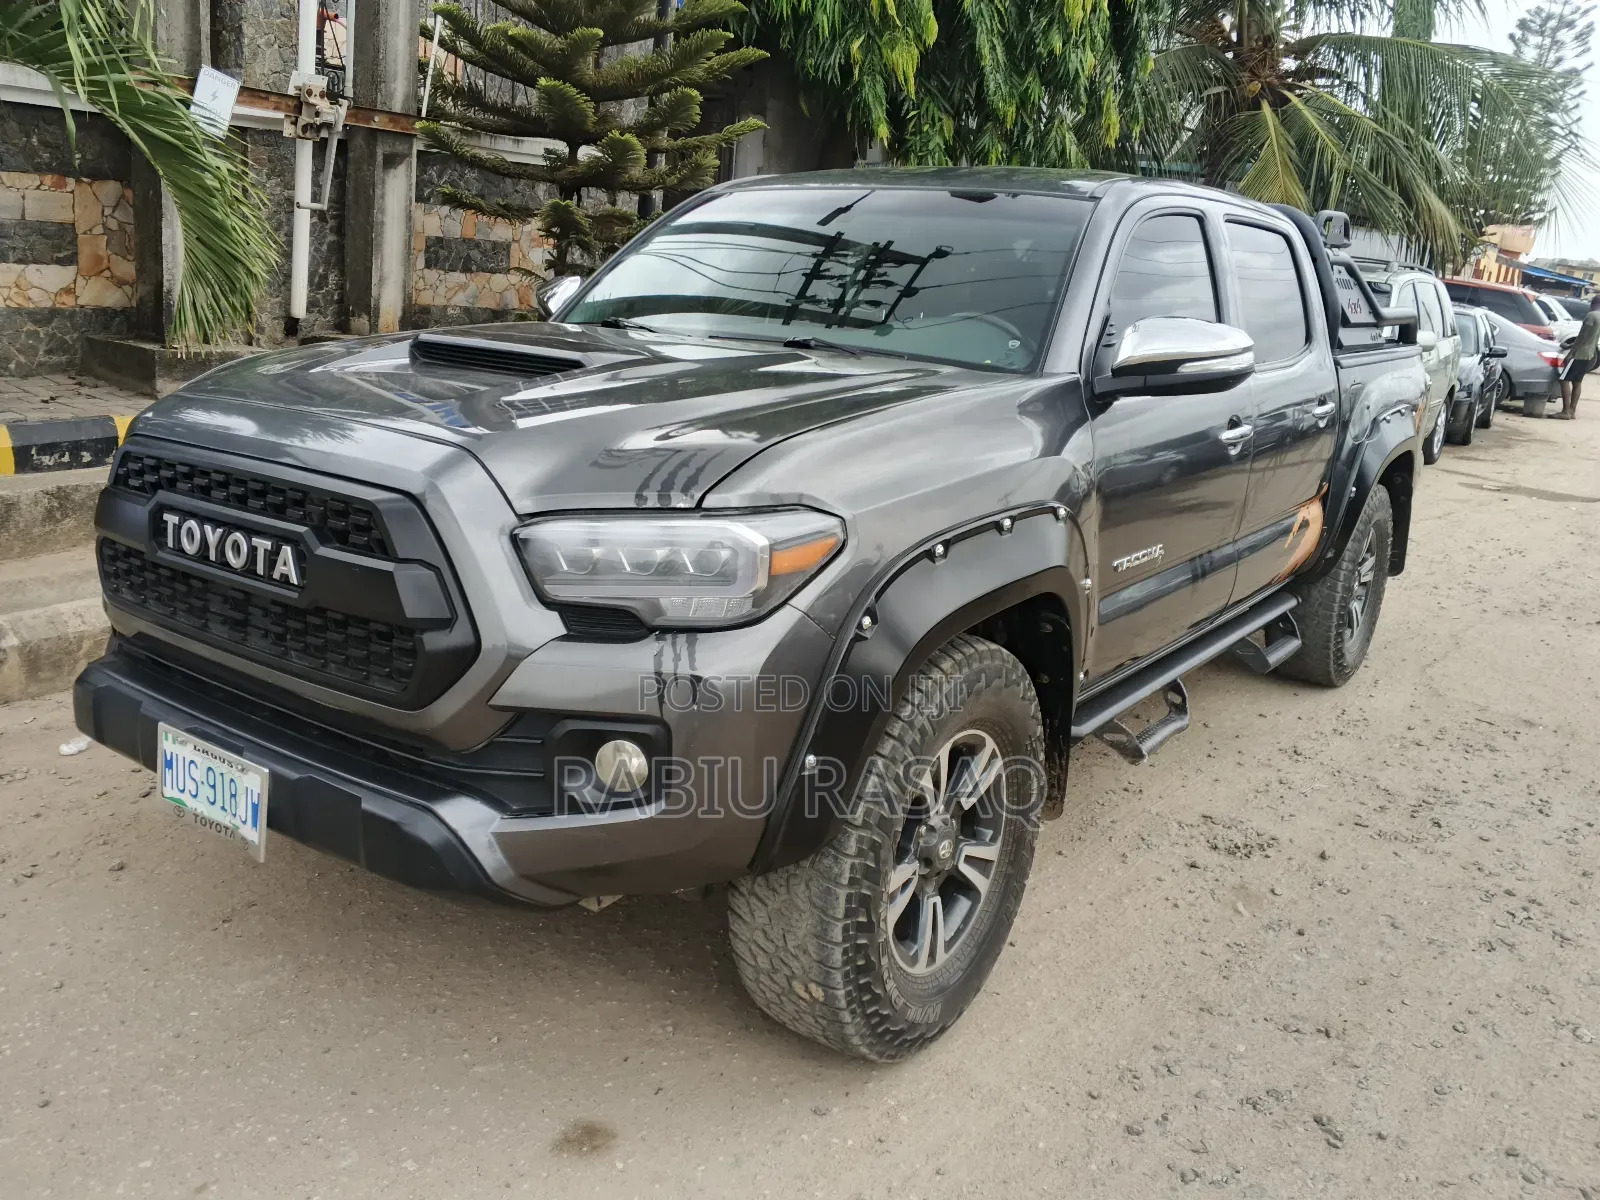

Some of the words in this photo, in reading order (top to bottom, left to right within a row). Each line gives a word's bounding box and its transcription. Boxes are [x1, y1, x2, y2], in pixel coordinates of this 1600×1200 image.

[203, 69, 236, 90] DANGER
[163, 513, 299, 586] TOYOTA
[193, 812, 235, 840] TOYOTA
